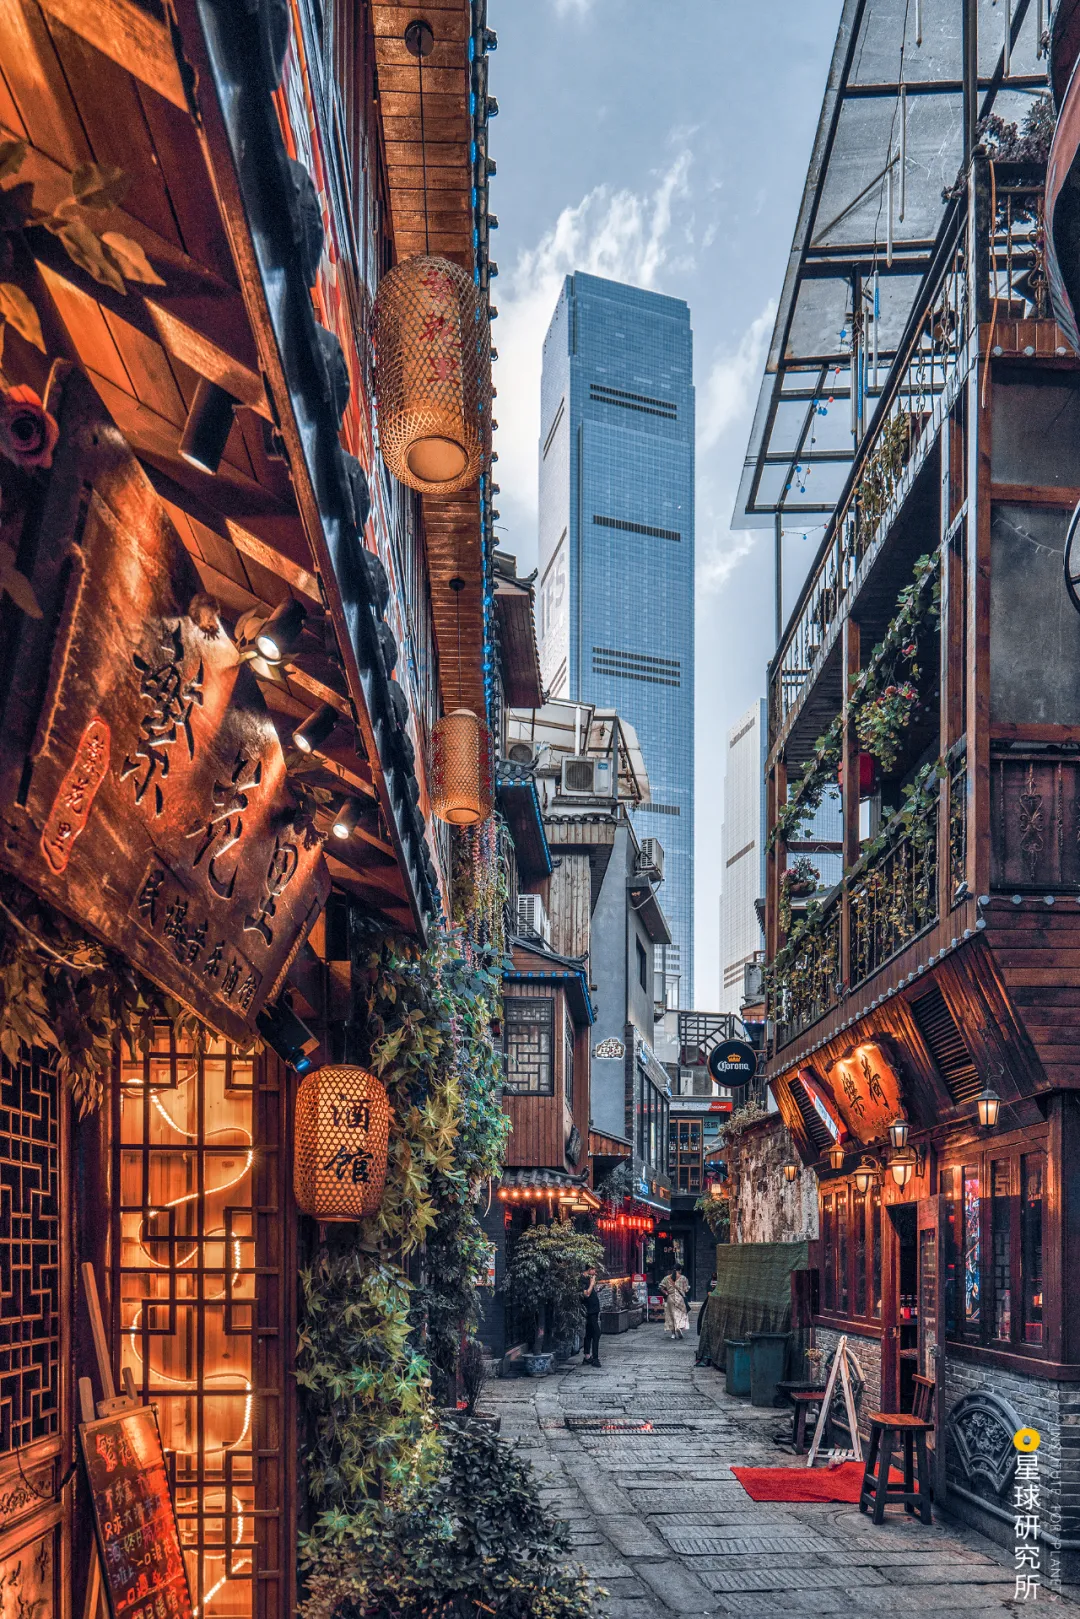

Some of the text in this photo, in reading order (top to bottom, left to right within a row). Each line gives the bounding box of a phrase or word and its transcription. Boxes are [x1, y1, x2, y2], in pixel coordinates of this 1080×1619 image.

[541, 551, 566, 641] IFS
[717, 1060, 750, 1073] Corona
[323, 1094, 375, 1185] 酒馆
